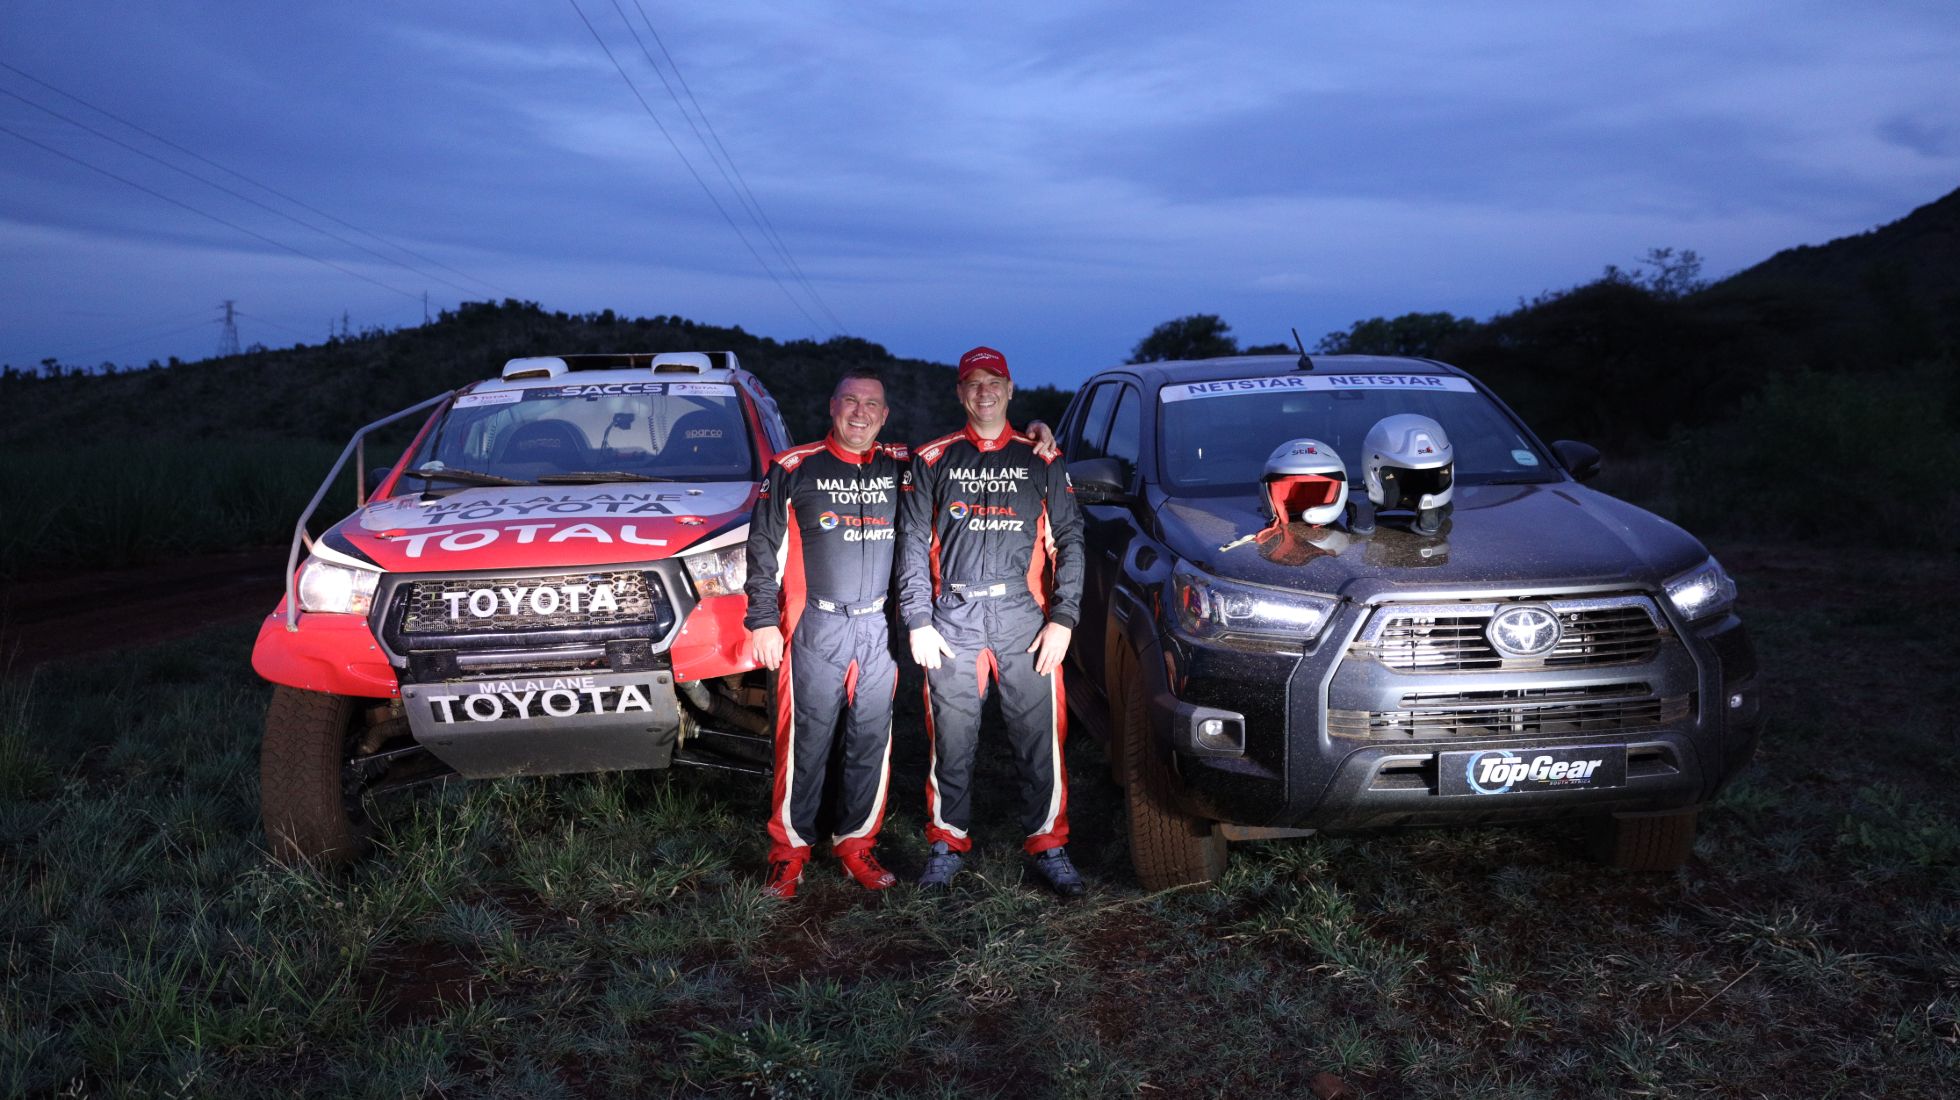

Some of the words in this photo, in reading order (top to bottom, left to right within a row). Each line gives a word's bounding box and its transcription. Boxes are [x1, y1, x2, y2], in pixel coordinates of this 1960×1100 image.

[561, 383, 662, 396] SACCS
[1188, 377, 1304, 394] NETSTAR
[1329, 375, 1444, 387] NETSTAR
[685, 429, 723, 438] sparco
[950, 468, 1029, 482] MALALANE
[817, 476, 895, 492] MALALANE
[959, 480, 1018, 493] TOYOTA
[424, 493, 682, 513] MALALANE
[829, 490, 888, 505] TOYOTA
[423, 502, 675, 525] TOYOTA
[969, 504, 1016, 517] TOTAL
[842, 514, 890, 527] TOTAL
[968, 518, 1024, 531] QUARTZ
[391, 523, 668, 558] TOTAL
[843, 528, 895, 542] QUARTZ
[442, 584, 618, 619] TOYOTA
[479, 677, 596, 694] MALALANE
[428, 684, 653, 724] TOYOTA
